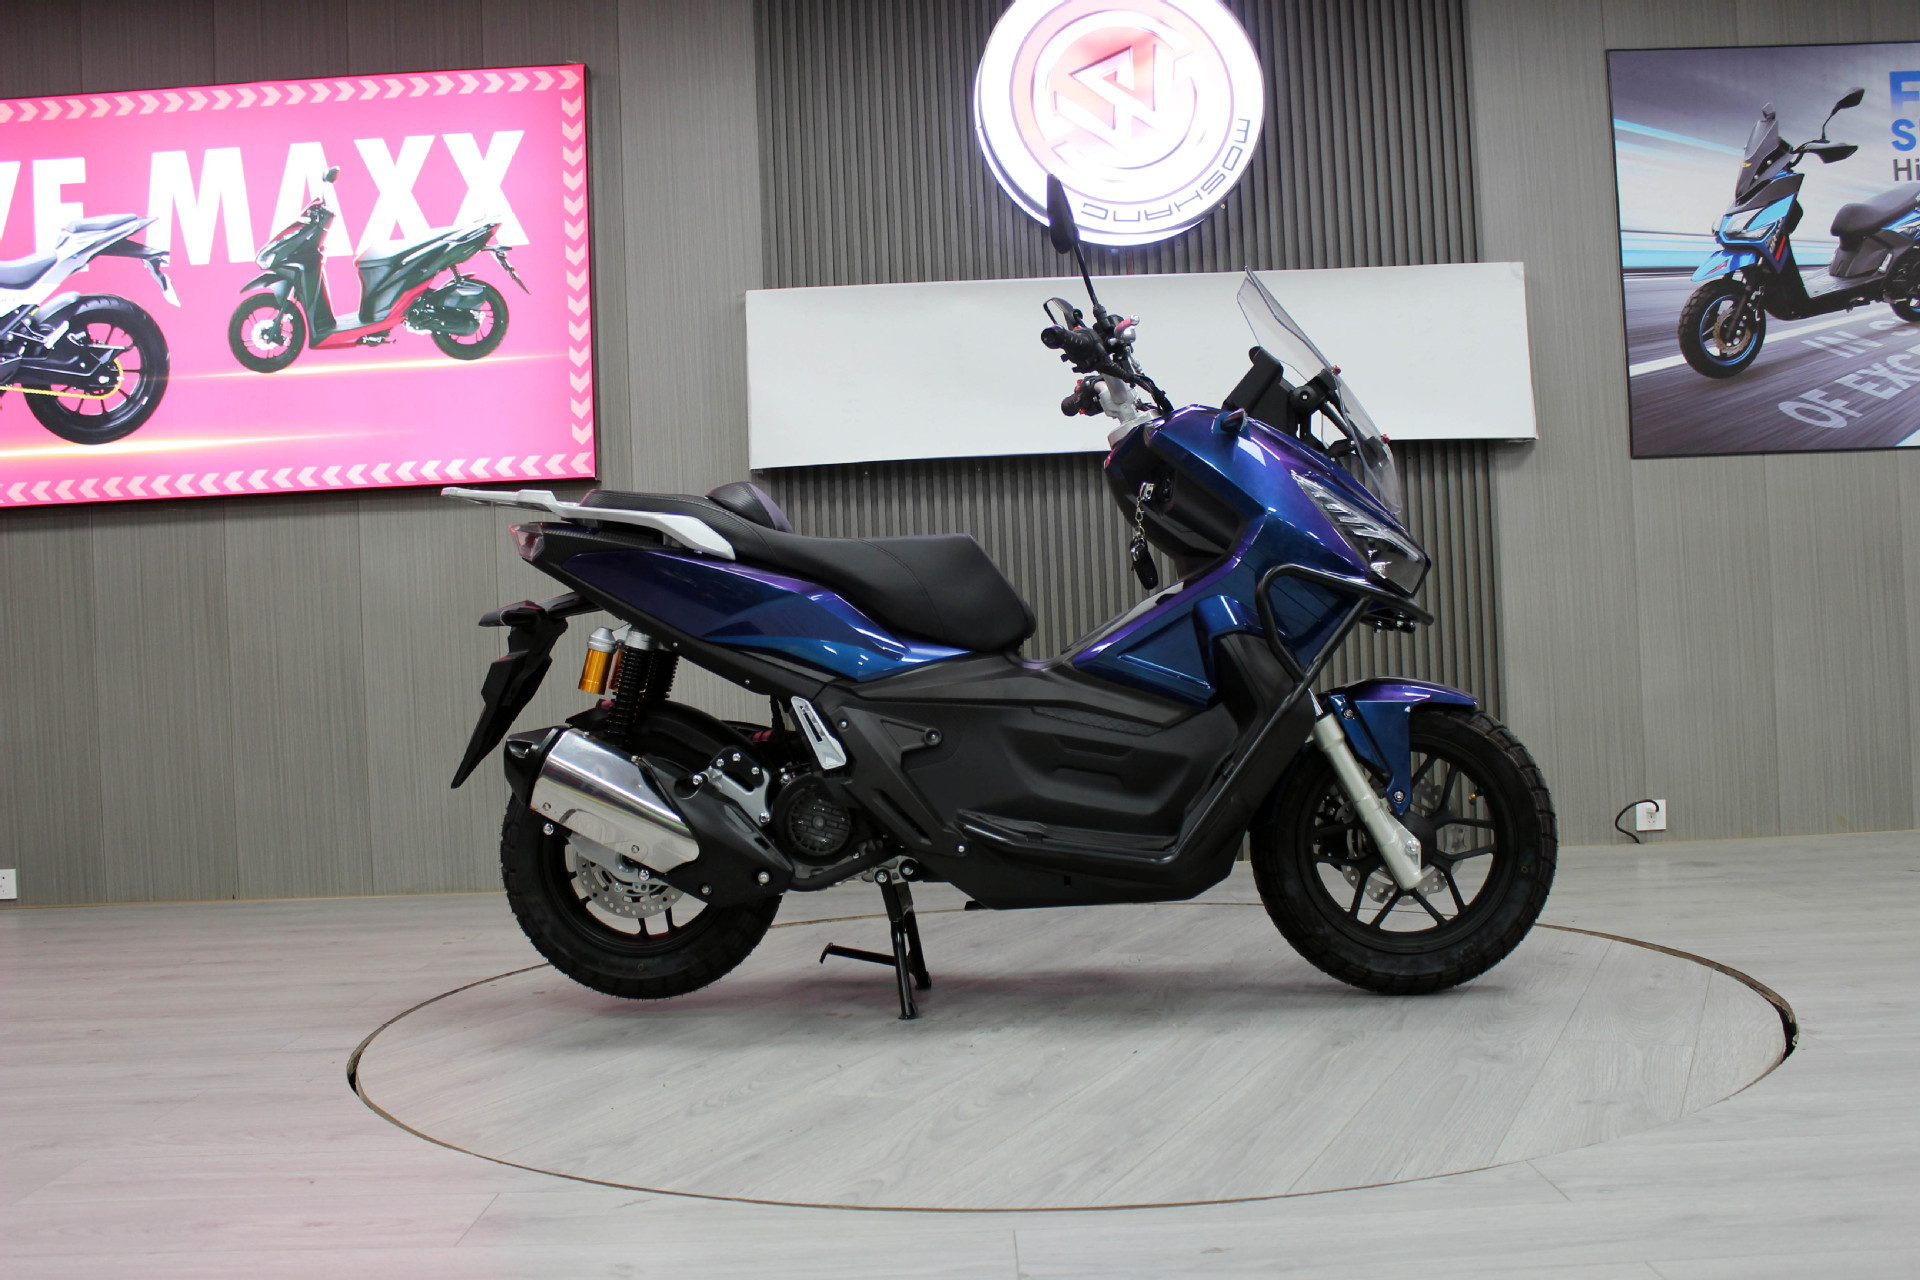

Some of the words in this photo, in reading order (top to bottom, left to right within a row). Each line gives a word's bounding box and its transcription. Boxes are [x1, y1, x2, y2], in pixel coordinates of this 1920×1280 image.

[1080, 118, 1251, 222] MOSHANG
[1891, 118, 1920, 151] S
[0, 157, 89, 272] E
[145, 130, 530, 266] MAXX
[1778, 388, 1863, 428] OF
[1834, 343, 1920, 400] EXC
[1800, 330, 1884, 358] IN
